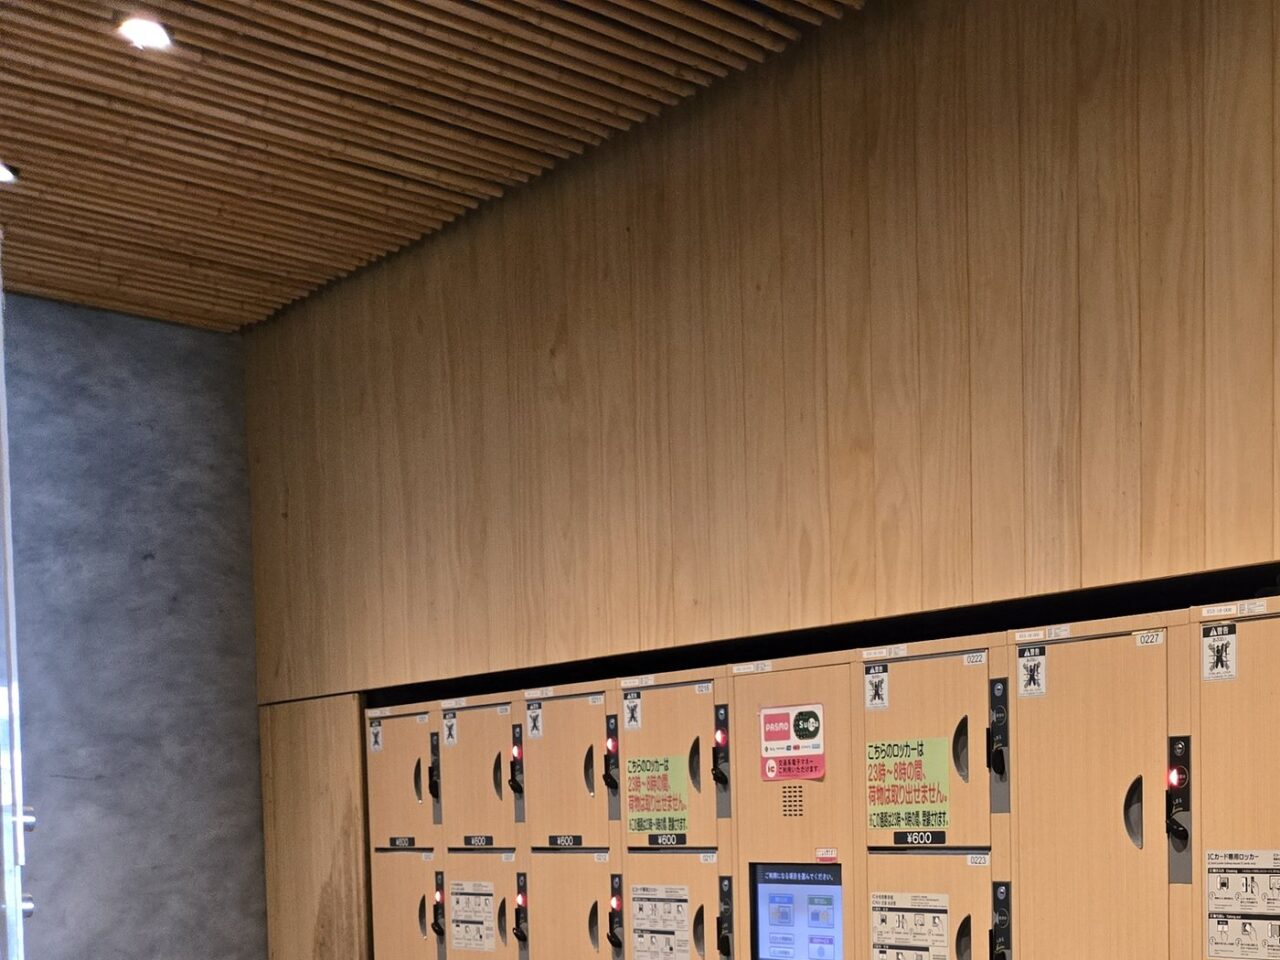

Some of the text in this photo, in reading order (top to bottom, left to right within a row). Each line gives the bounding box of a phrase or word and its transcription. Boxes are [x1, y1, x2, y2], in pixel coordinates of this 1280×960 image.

[1140, 633, 1159, 645] 0227
[967, 654, 983, 664] 0222
[765, 722, 789, 732] PASMO
[868, 740, 924, 760] こちらのロッカーは
[868, 783, 948, 806] 荷物は取り出せません。
[557, 837, 574, 845] ¥600
[657, 834, 677, 845] ¥600
[907, 832, 932, 844] ¥600
[970, 856, 987, 864] 0223
